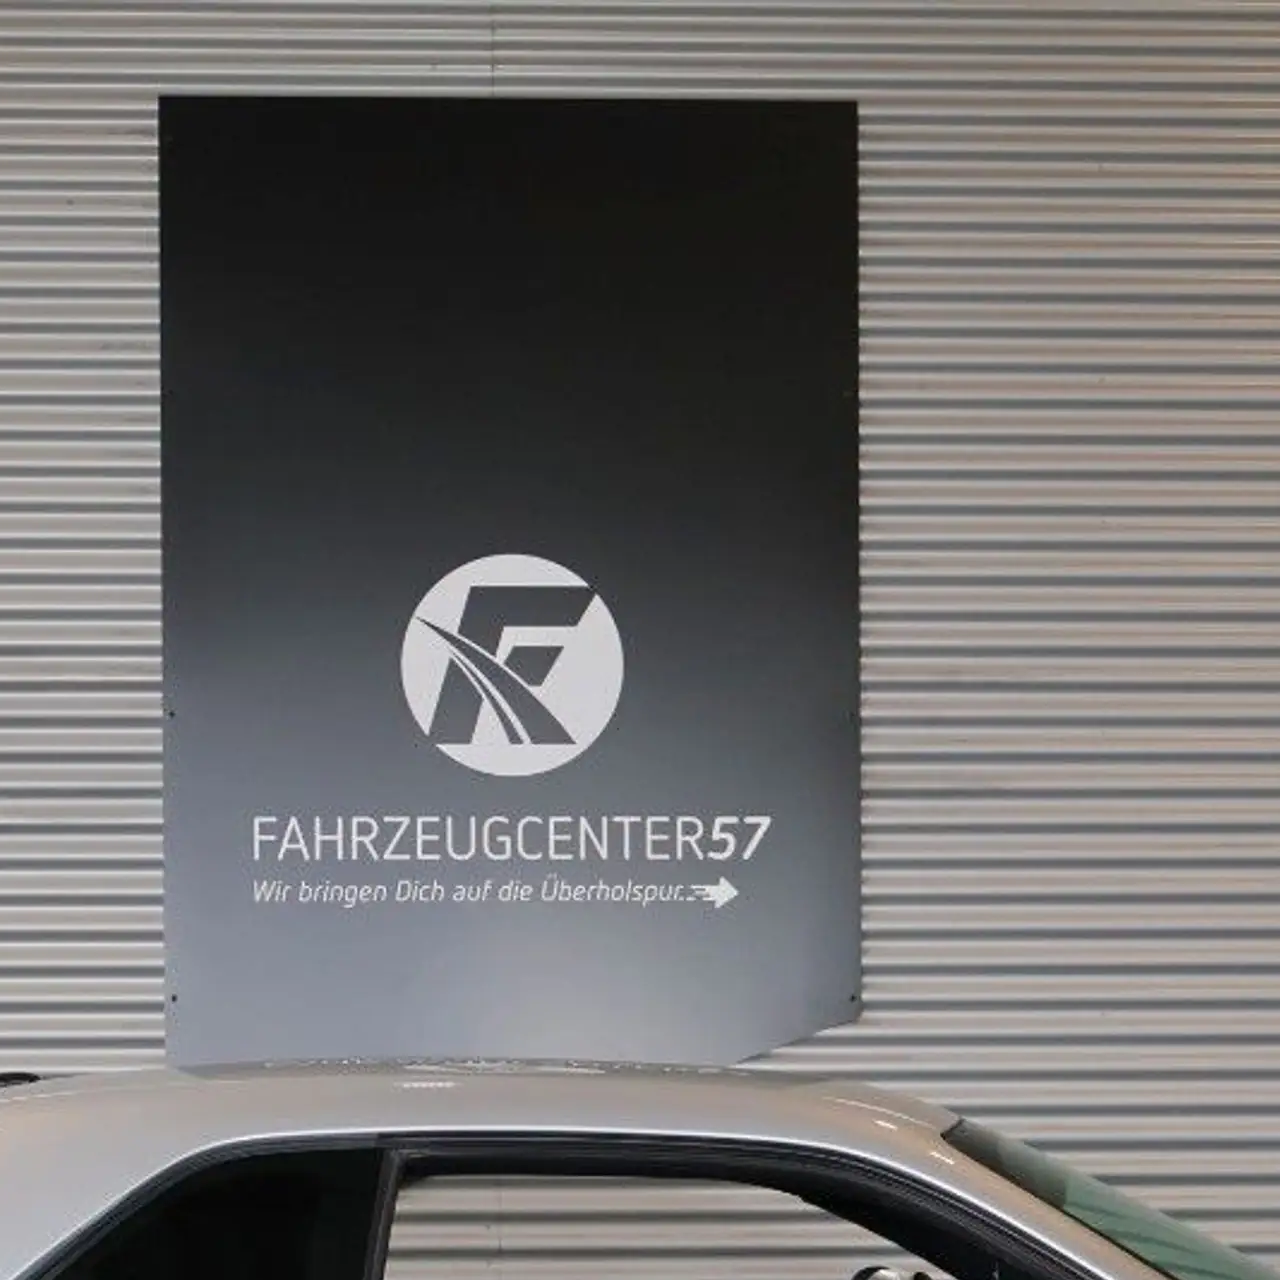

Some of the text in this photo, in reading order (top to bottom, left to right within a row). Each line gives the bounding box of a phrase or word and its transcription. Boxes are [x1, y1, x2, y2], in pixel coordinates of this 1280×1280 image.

[253, 816, 772, 861] FAHRZEUGCENTER57
[253, 880, 293, 902] Wir
[299, 880, 388, 909] bringen
[395, 880, 446, 903] Dich
[452, 880, 494, 903] auf
[498, 880, 534, 902] die
